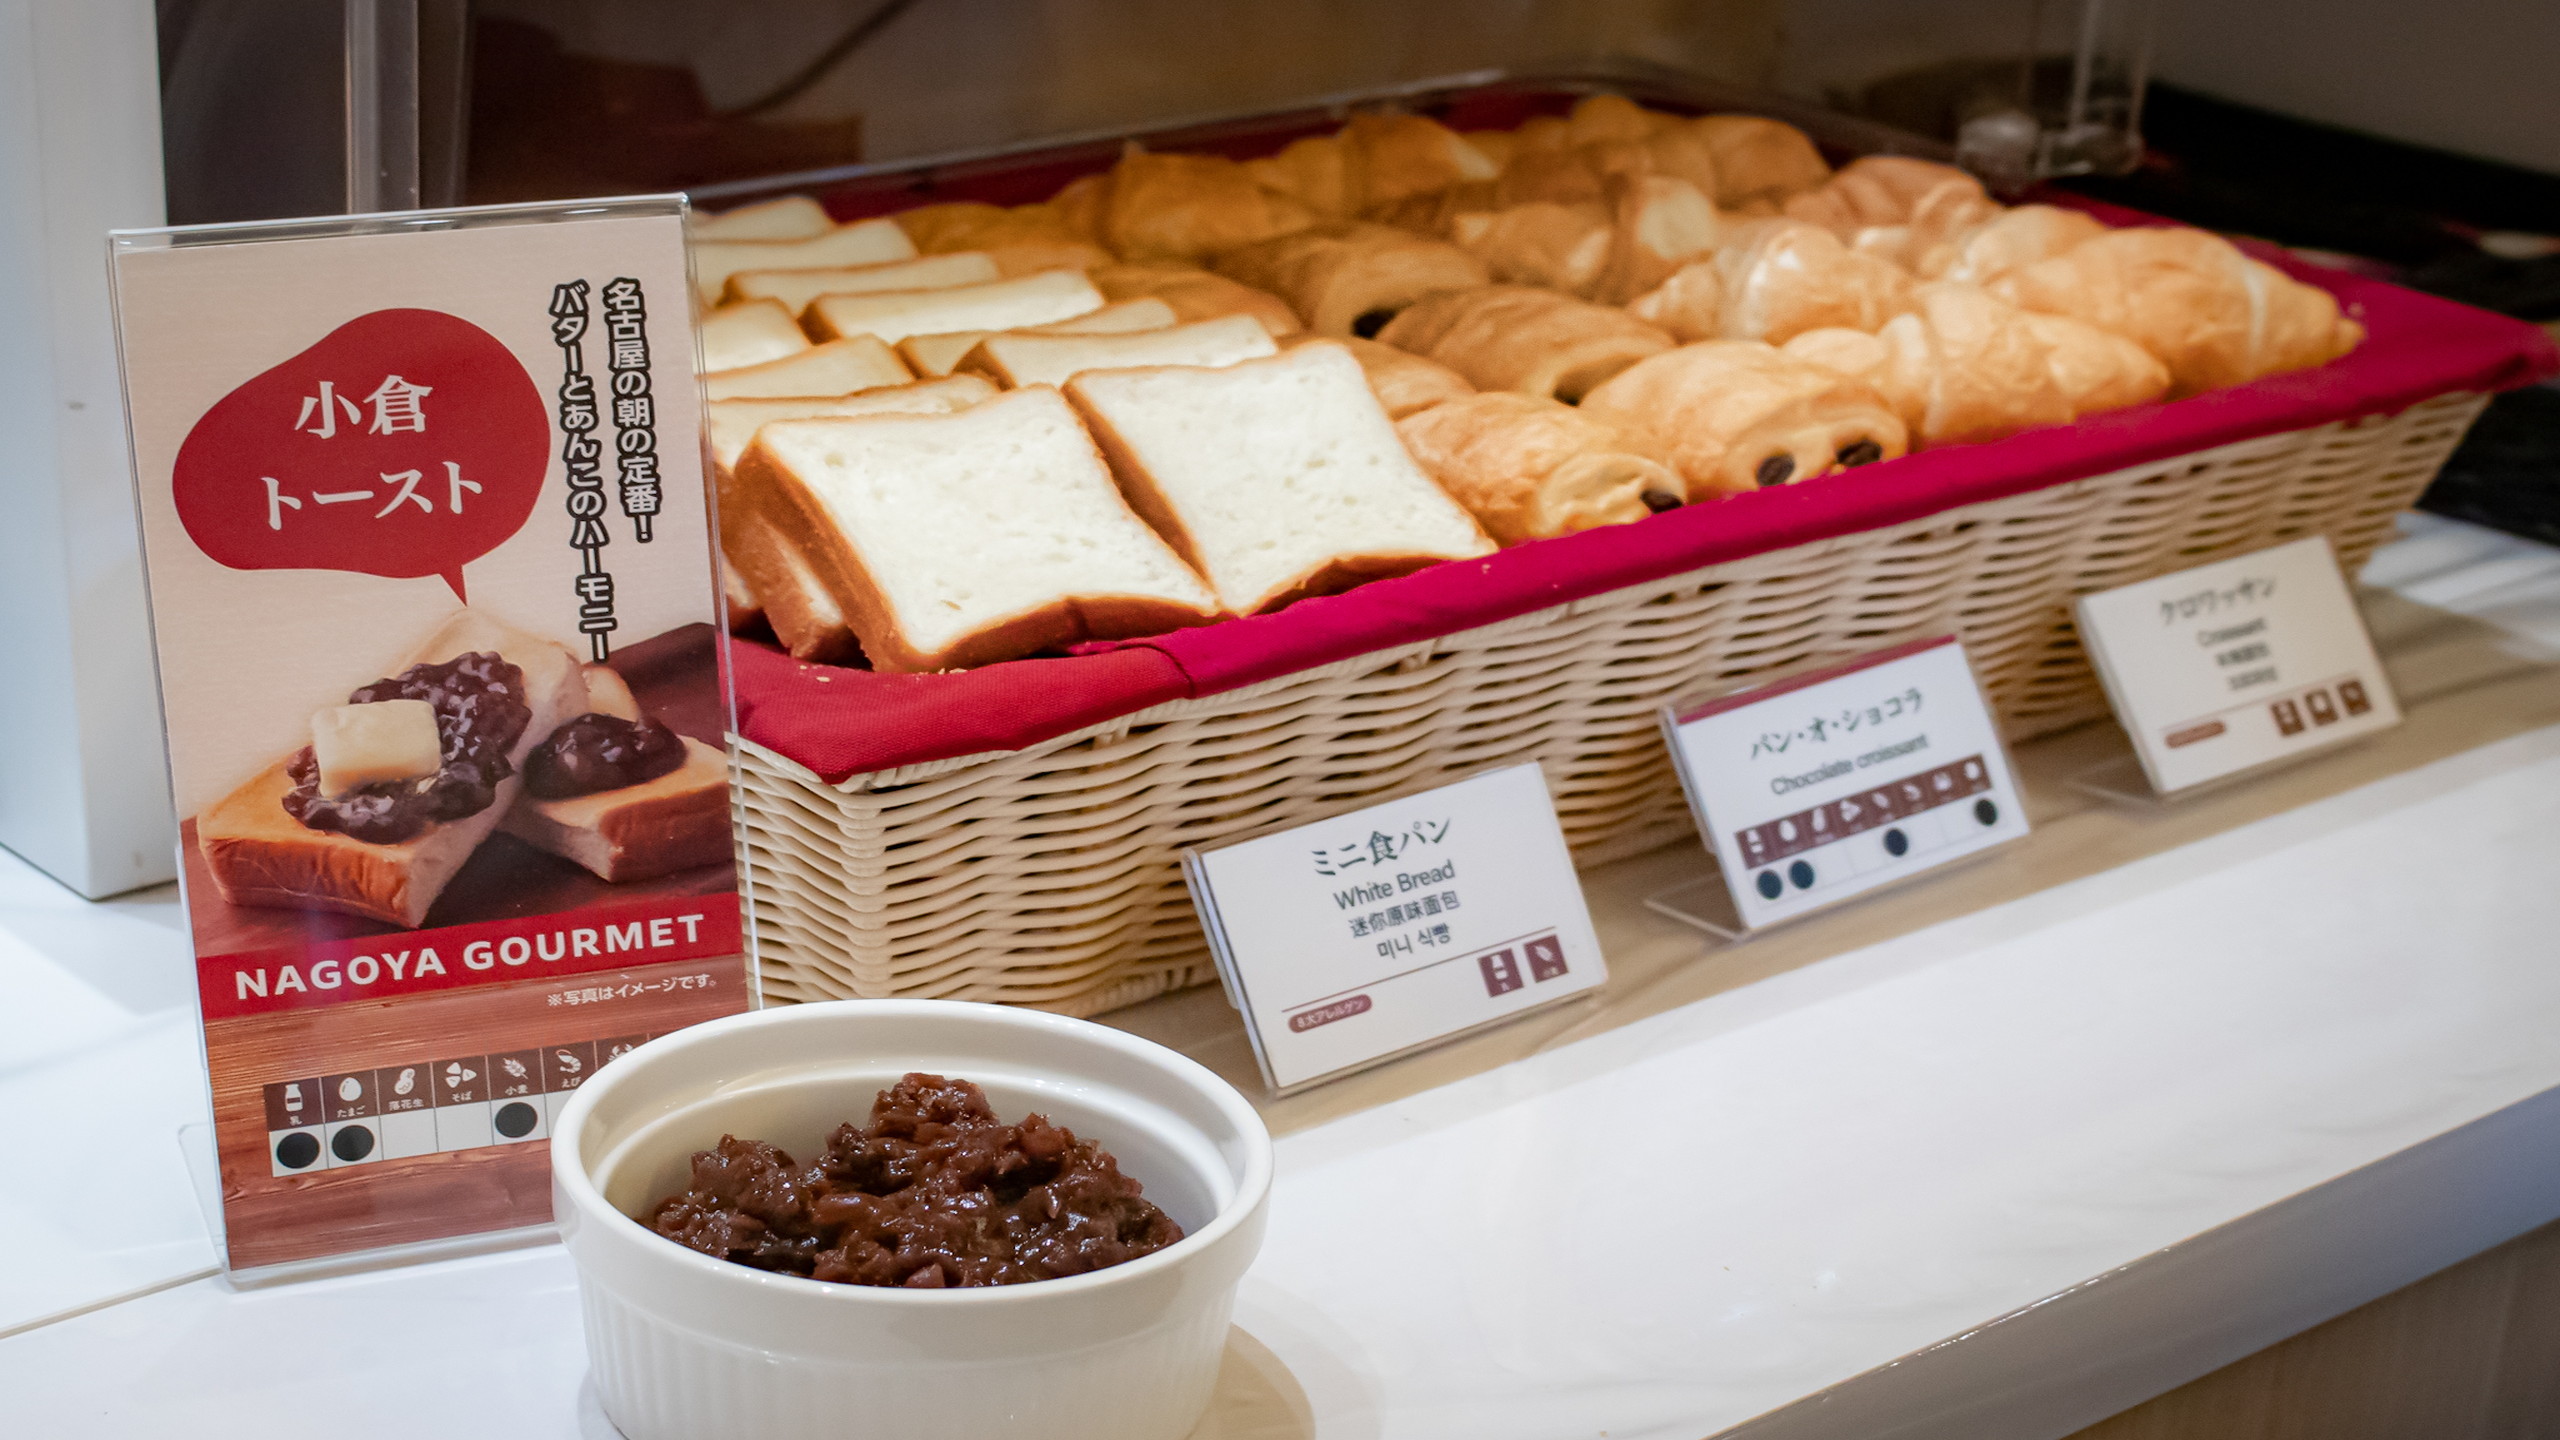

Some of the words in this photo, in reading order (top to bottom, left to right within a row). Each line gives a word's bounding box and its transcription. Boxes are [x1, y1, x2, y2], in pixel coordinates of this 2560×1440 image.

[294, 374, 433, 439] 小倉
[604, 277, 661, 542] 名古屋の朝の定番！
[260, 461, 483, 530] トースト
[549, 279, 617, 662] バターとあんこのハーモニー
[1770, 757, 1853, 796] Chocolate
[1311, 817, 1451, 876] ミニ食パン
[1333, 879, 1394, 911] White
[1396, 859, 1456, 892] Bread
[1349, 890, 1461, 938] 迷你原味面包
[1376, 933, 1414, 960] 미니
[1417, 922, 1452, 947] 식빵
[235, 947, 446, 1000] NAGOYA
[463, 914, 705, 970] GOURMET
[547, 972, 717, 1007] ※写真はイメージです。
[337, 1104, 366, 1118] たまご
[388, 1097, 425, 1111] 落花生
[452, 1090, 473, 1102] そば
[505, 1083, 529, 1096] 小麦
